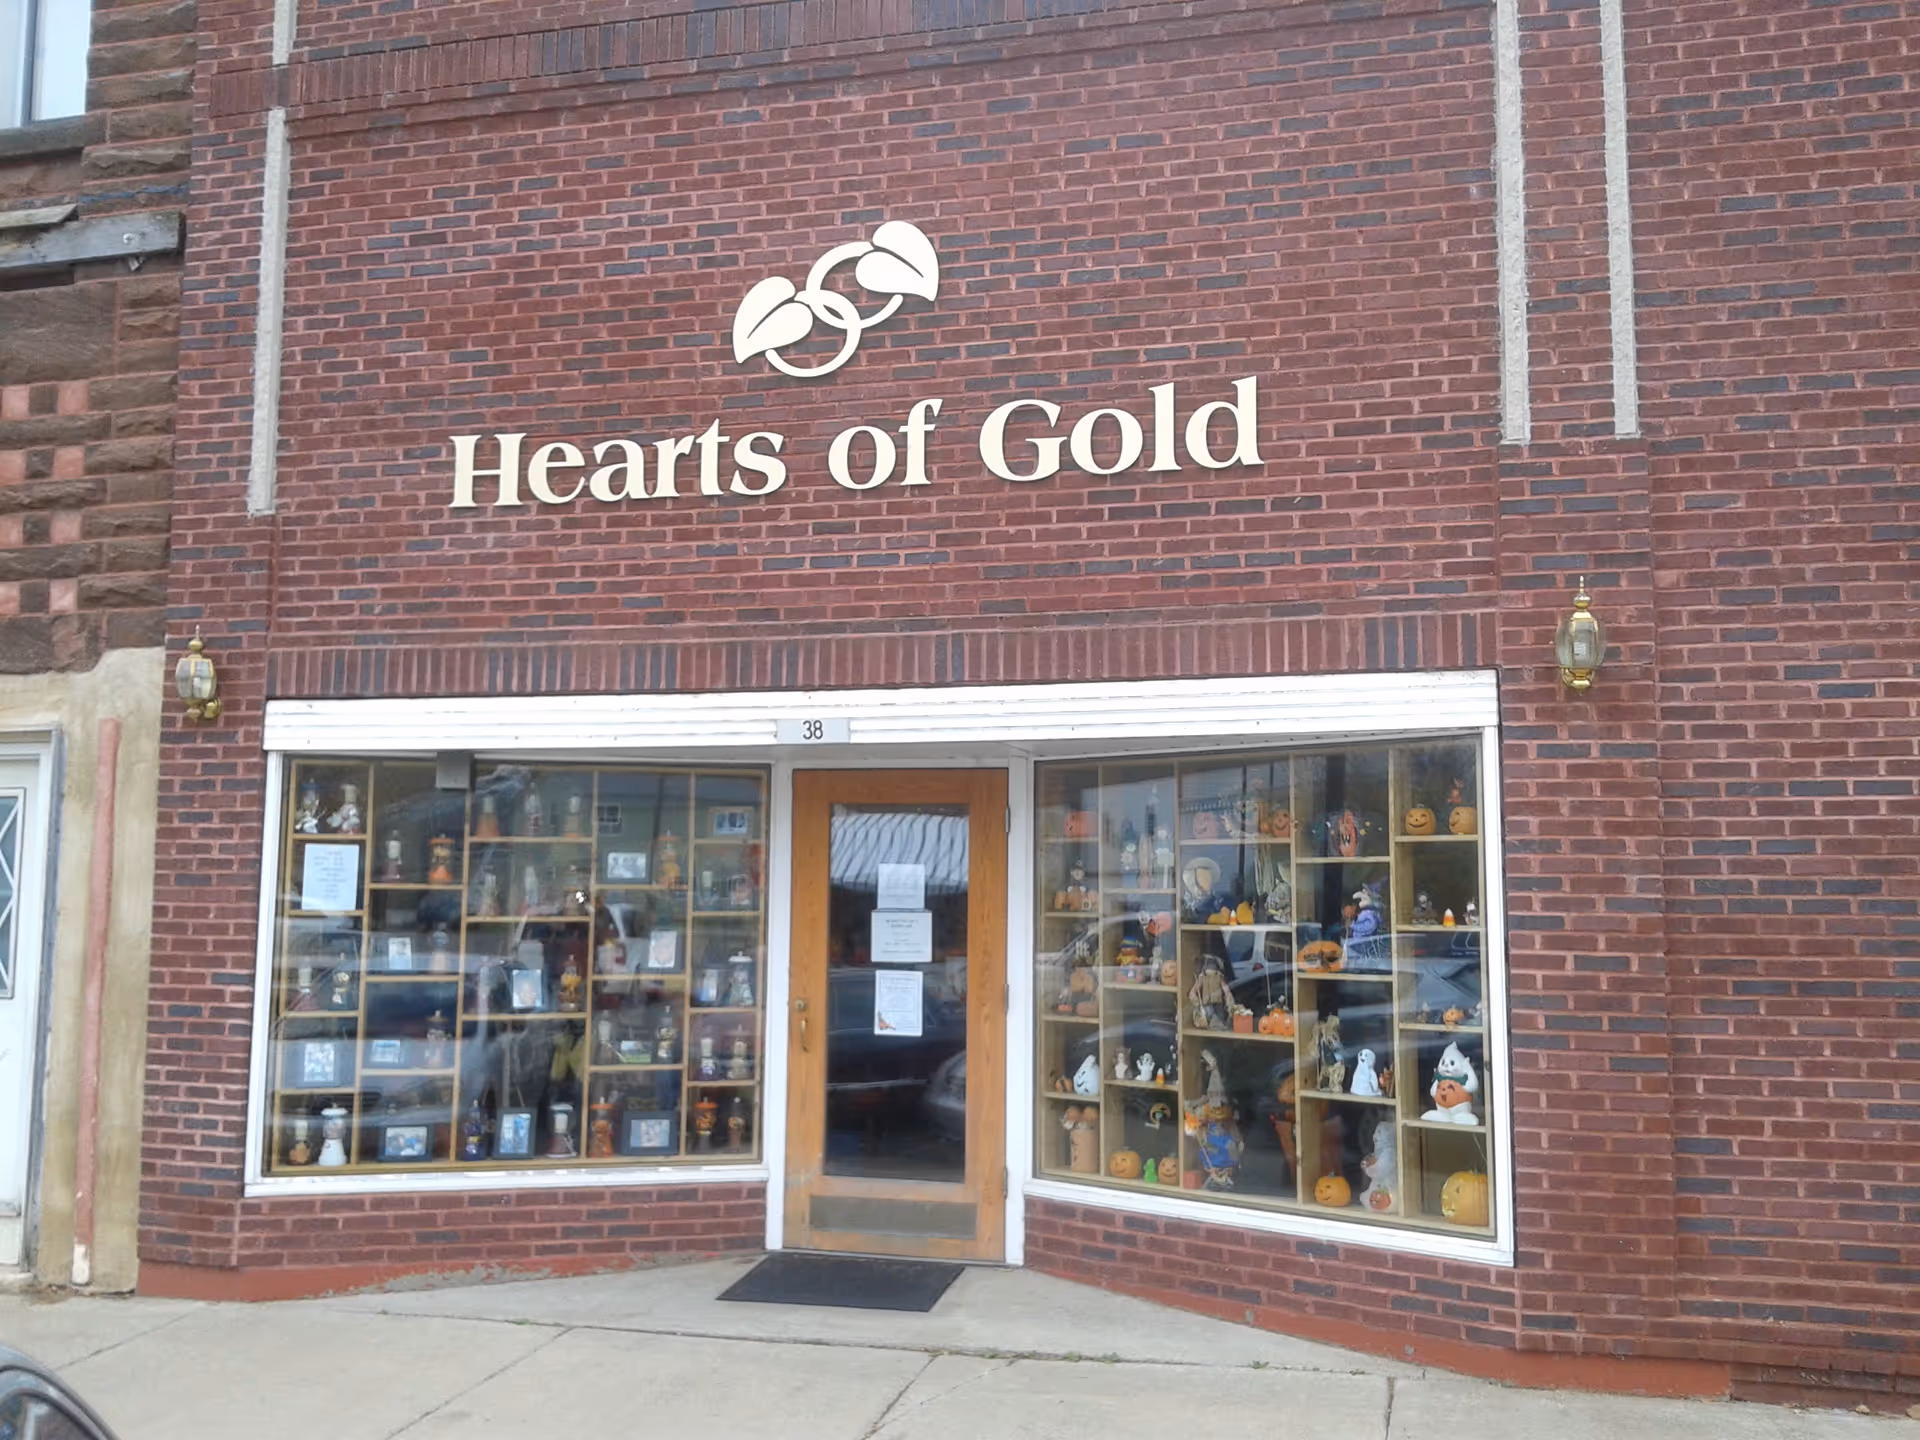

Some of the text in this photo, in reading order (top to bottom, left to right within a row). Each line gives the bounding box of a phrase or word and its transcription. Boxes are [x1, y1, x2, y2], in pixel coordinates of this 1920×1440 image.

[447, 375, 1265, 509] Hearts of Gold
[802, 719, 824, 740] 38
